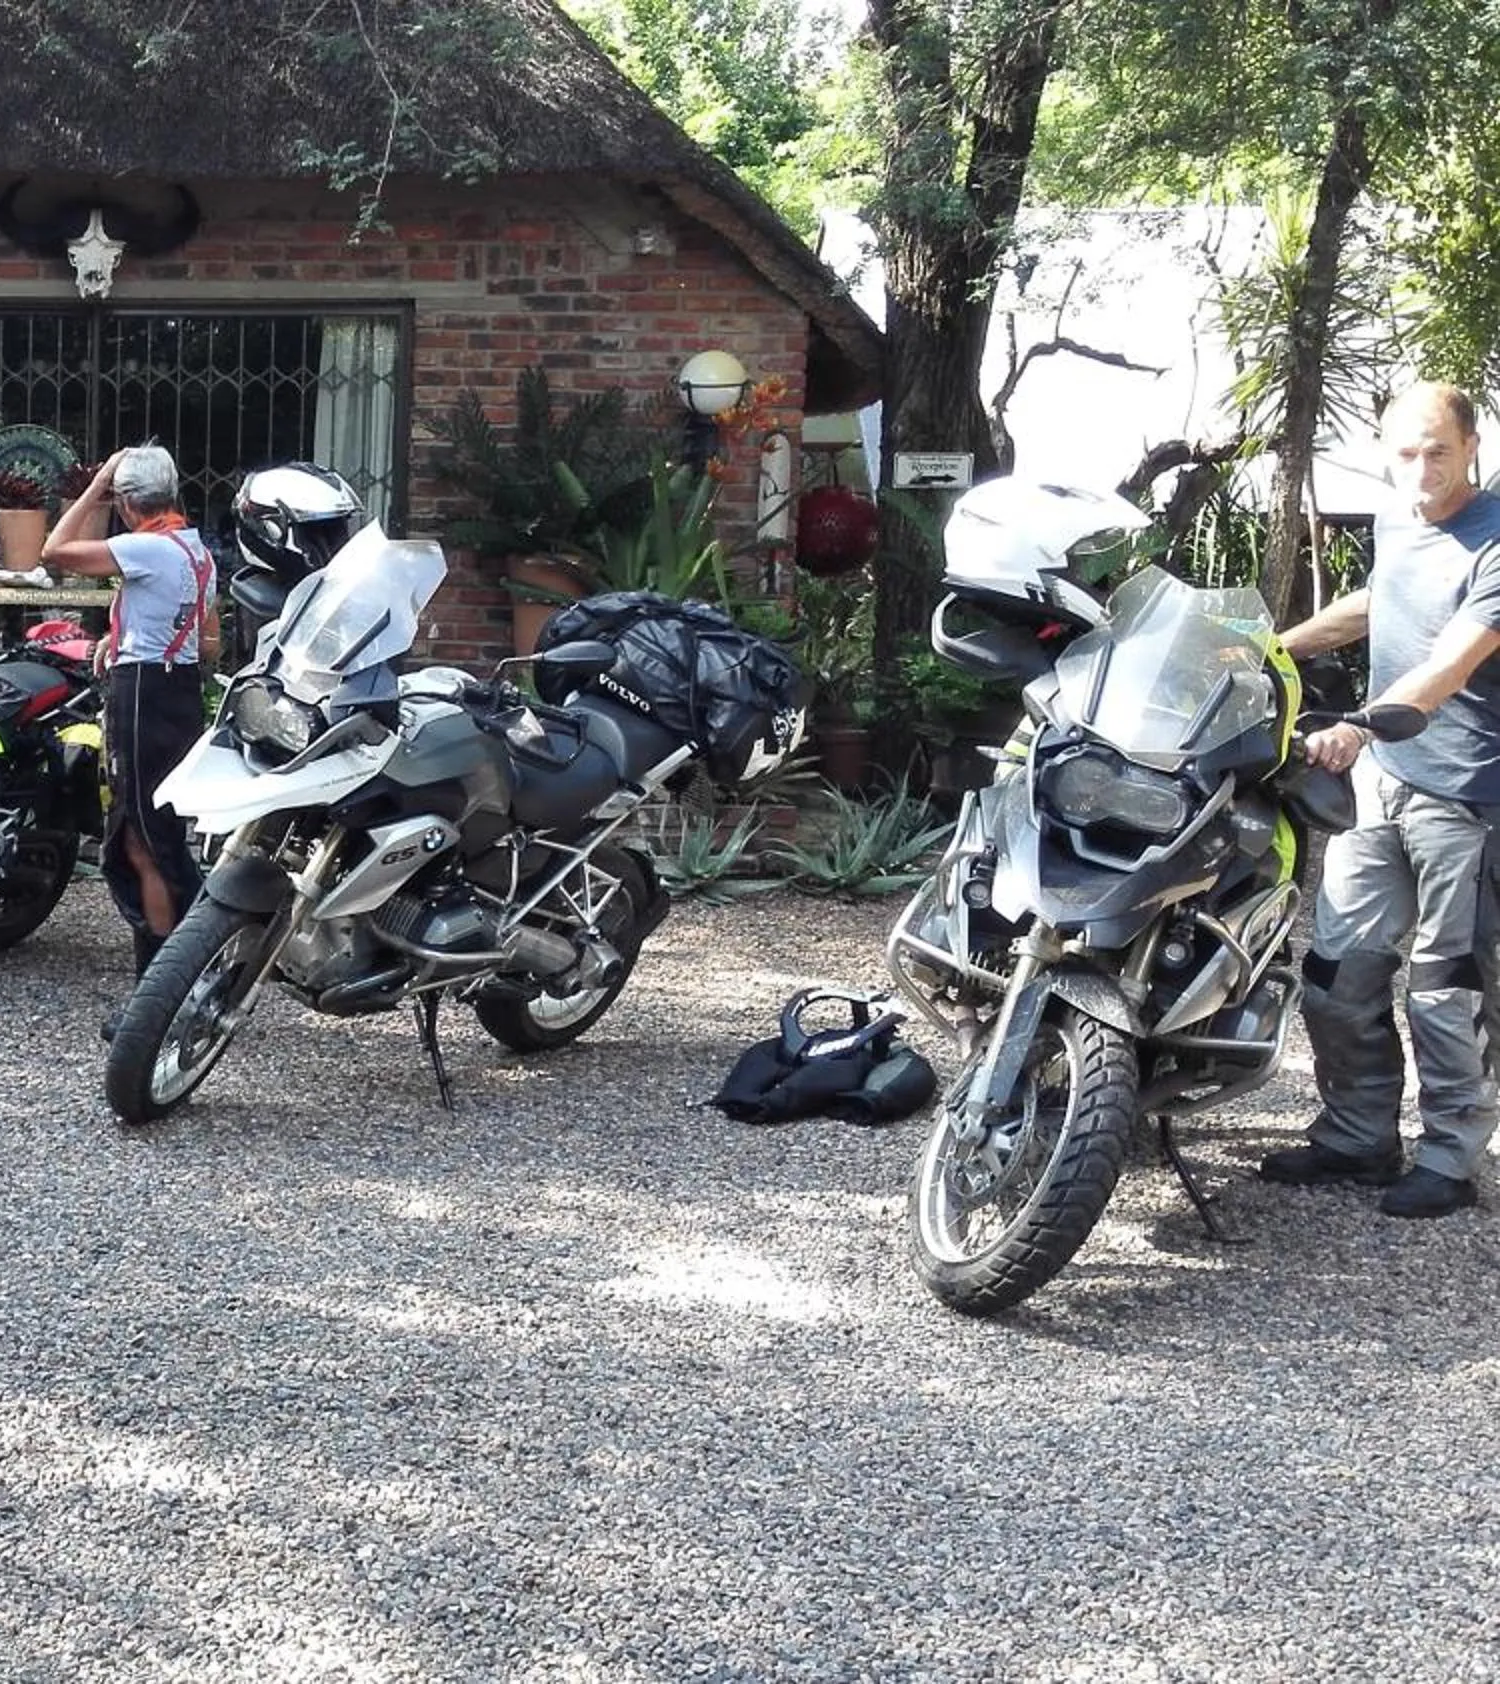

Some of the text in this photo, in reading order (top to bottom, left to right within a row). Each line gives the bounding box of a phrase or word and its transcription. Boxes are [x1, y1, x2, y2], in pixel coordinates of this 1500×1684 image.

[911, 462, 958, 473] Reception
[599, 673, 651, 712] VOLVO
[381, 845, 419, 866] GS
